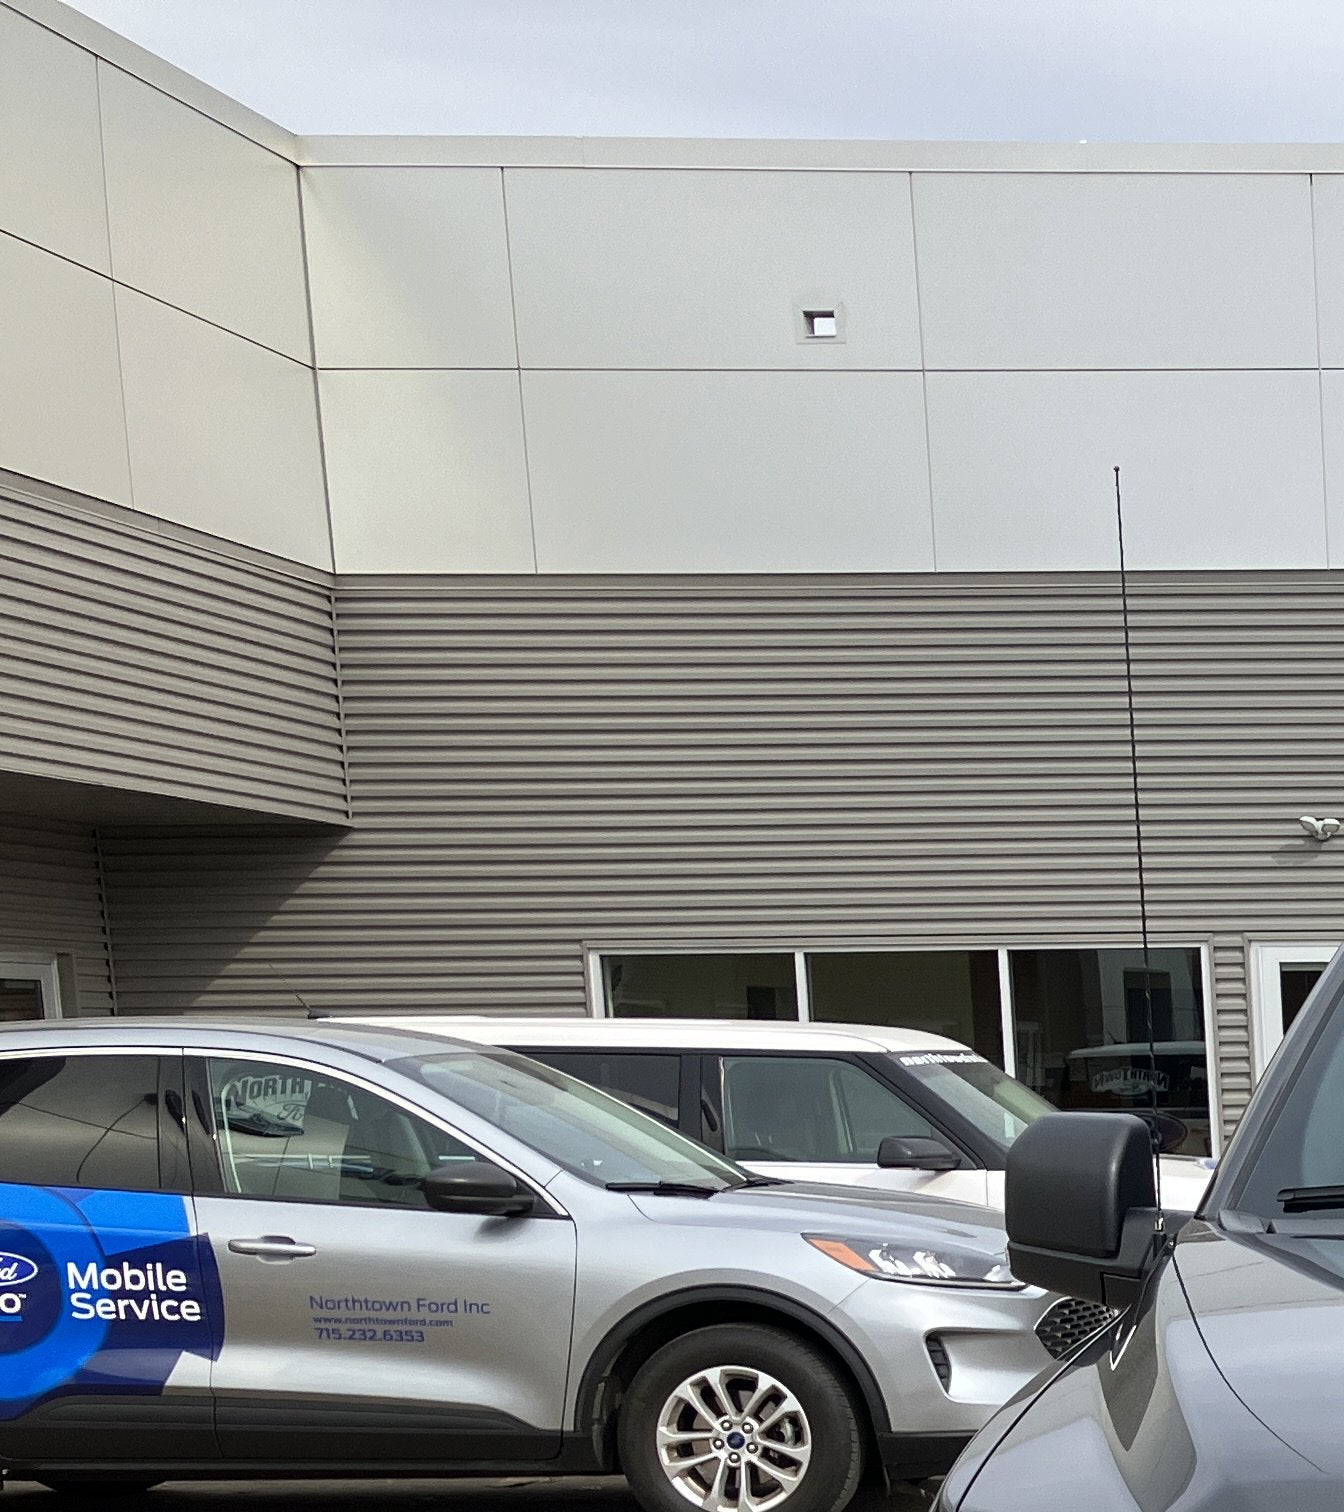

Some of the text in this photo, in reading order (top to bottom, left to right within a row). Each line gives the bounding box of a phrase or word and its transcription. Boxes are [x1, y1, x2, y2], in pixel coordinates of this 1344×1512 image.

[66, 1261, 187, 1292] Mobile
[70, 1292, 202, 1322] Service
[309, 1295, 491, 1315] Northtown Ford Inc
[314, 1327, 425, 1343] 715.232.6353
